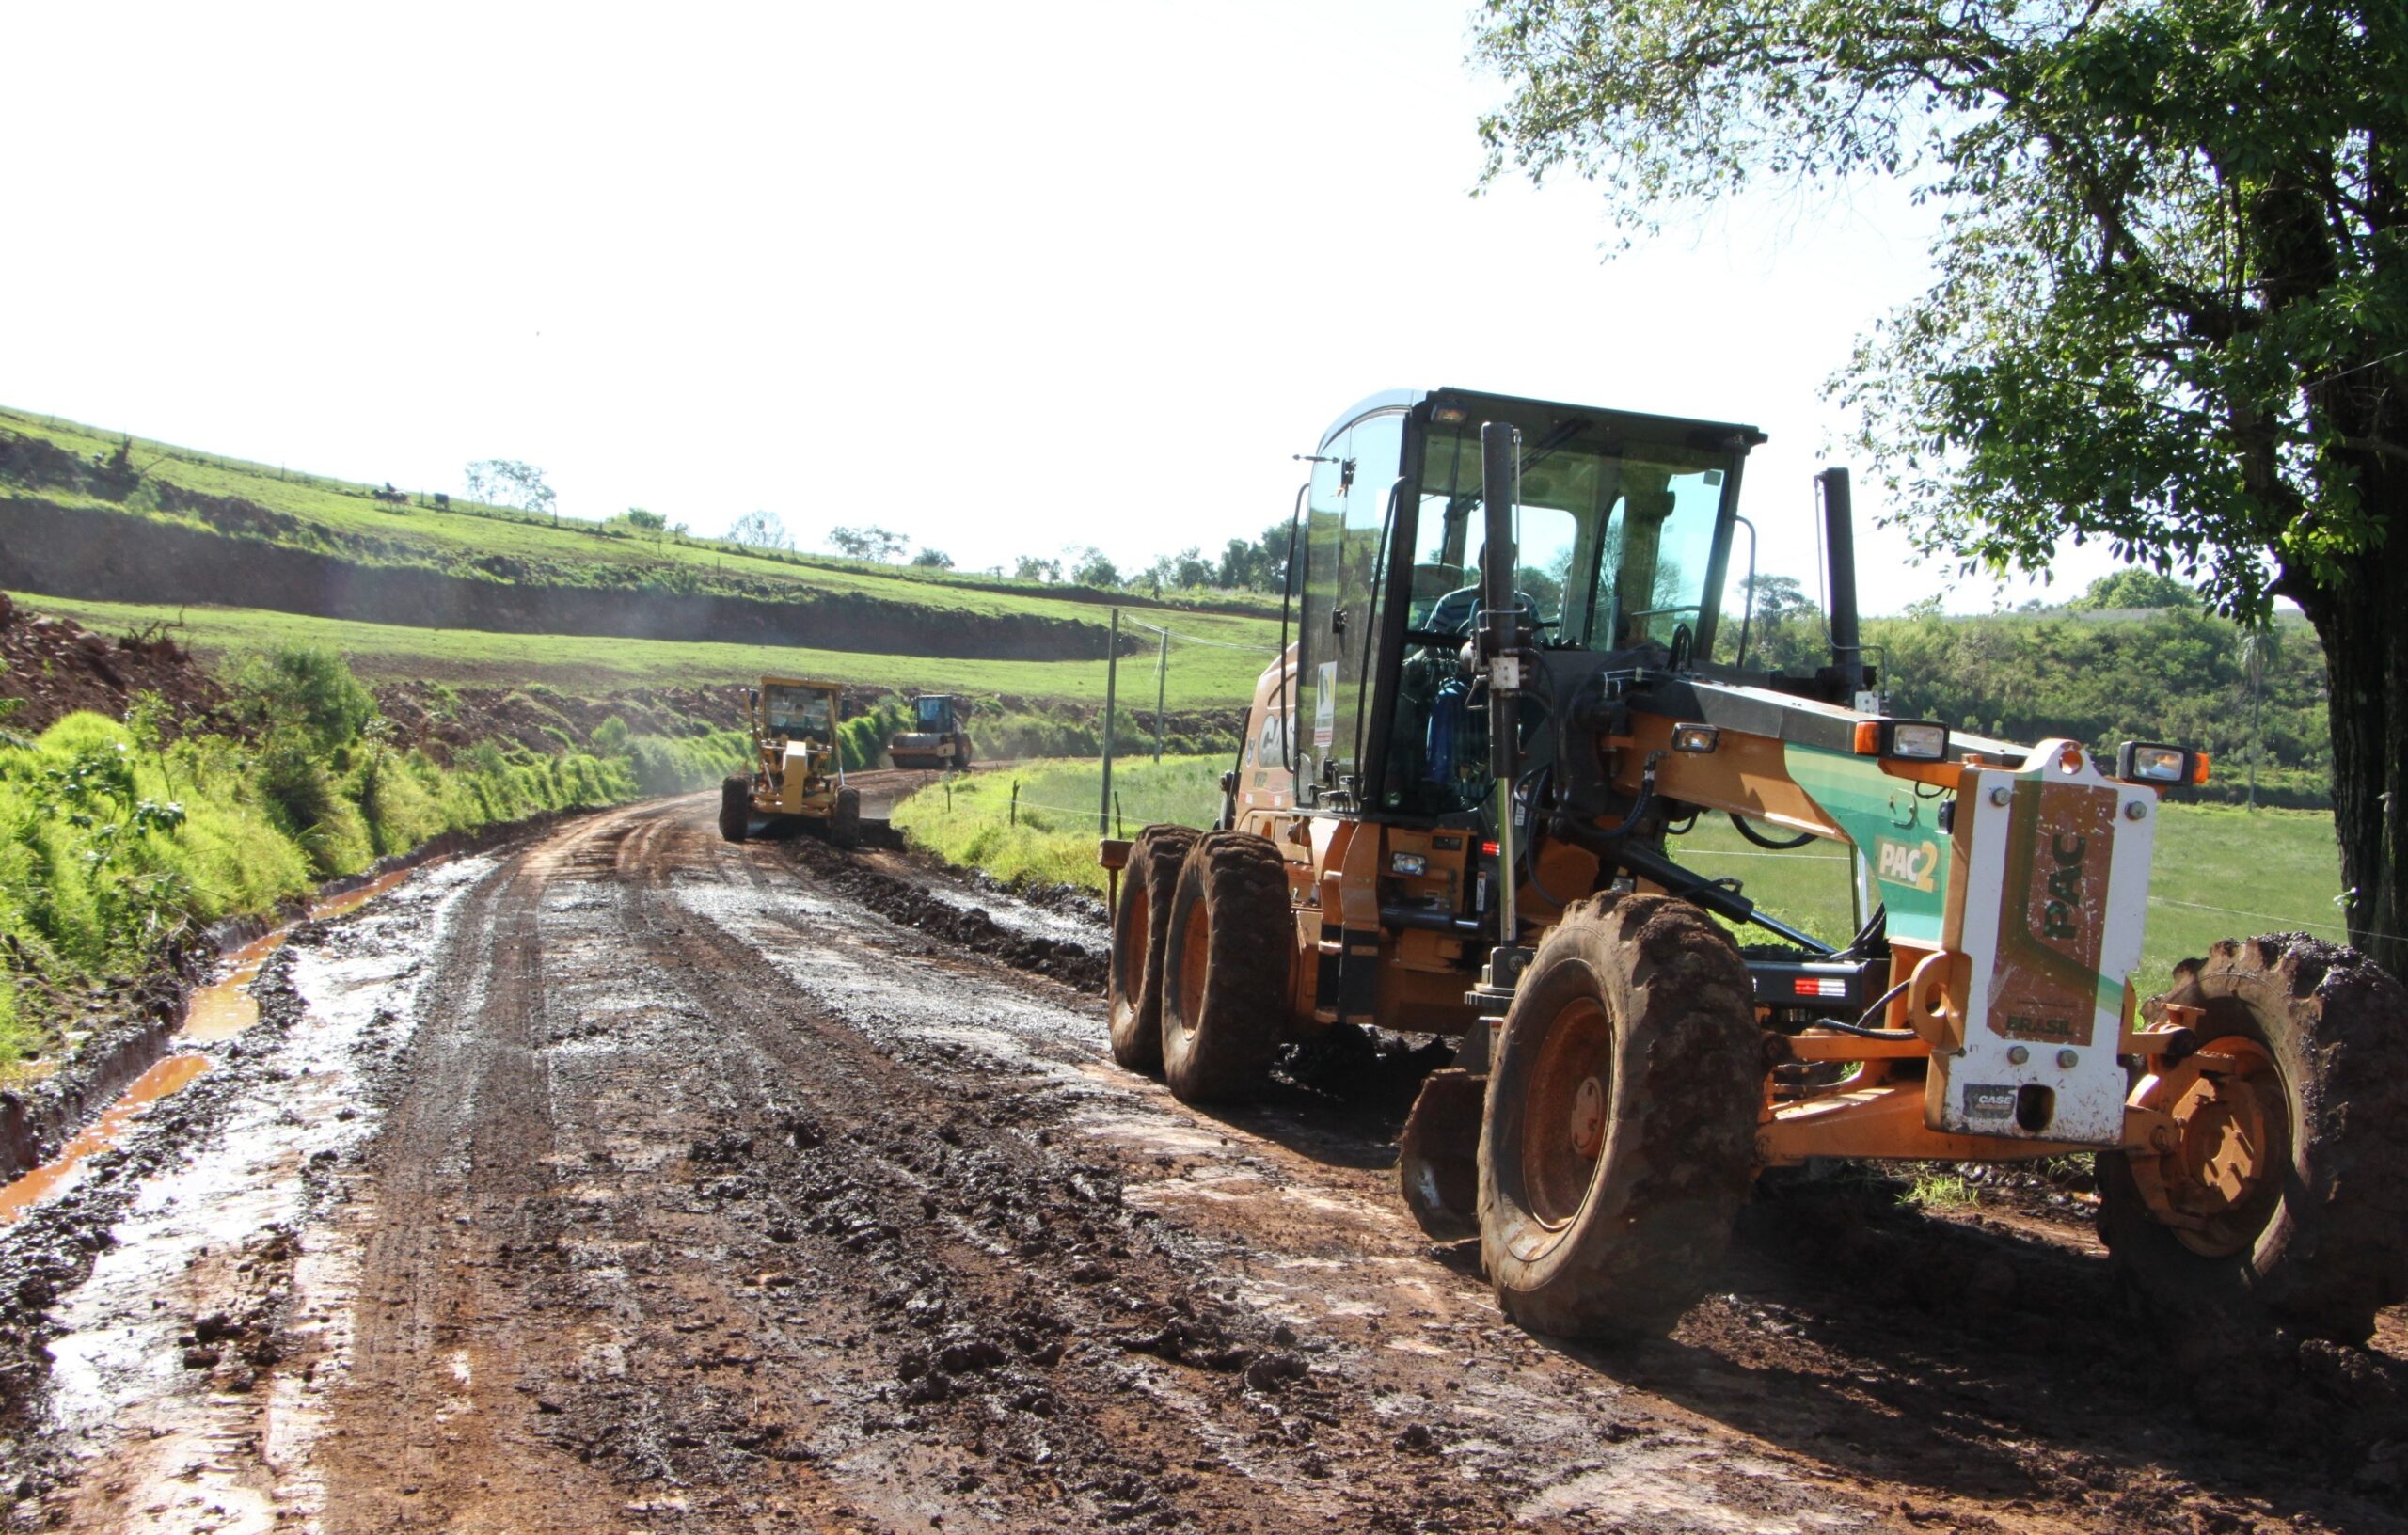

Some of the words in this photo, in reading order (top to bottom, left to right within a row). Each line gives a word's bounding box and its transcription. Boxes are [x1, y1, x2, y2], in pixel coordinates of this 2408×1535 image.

[1879, 840, 1938, 893] PAC2
[2043, 833, 2086, 939] PAC
[1978, 1095, 2014, 1104] CASE
